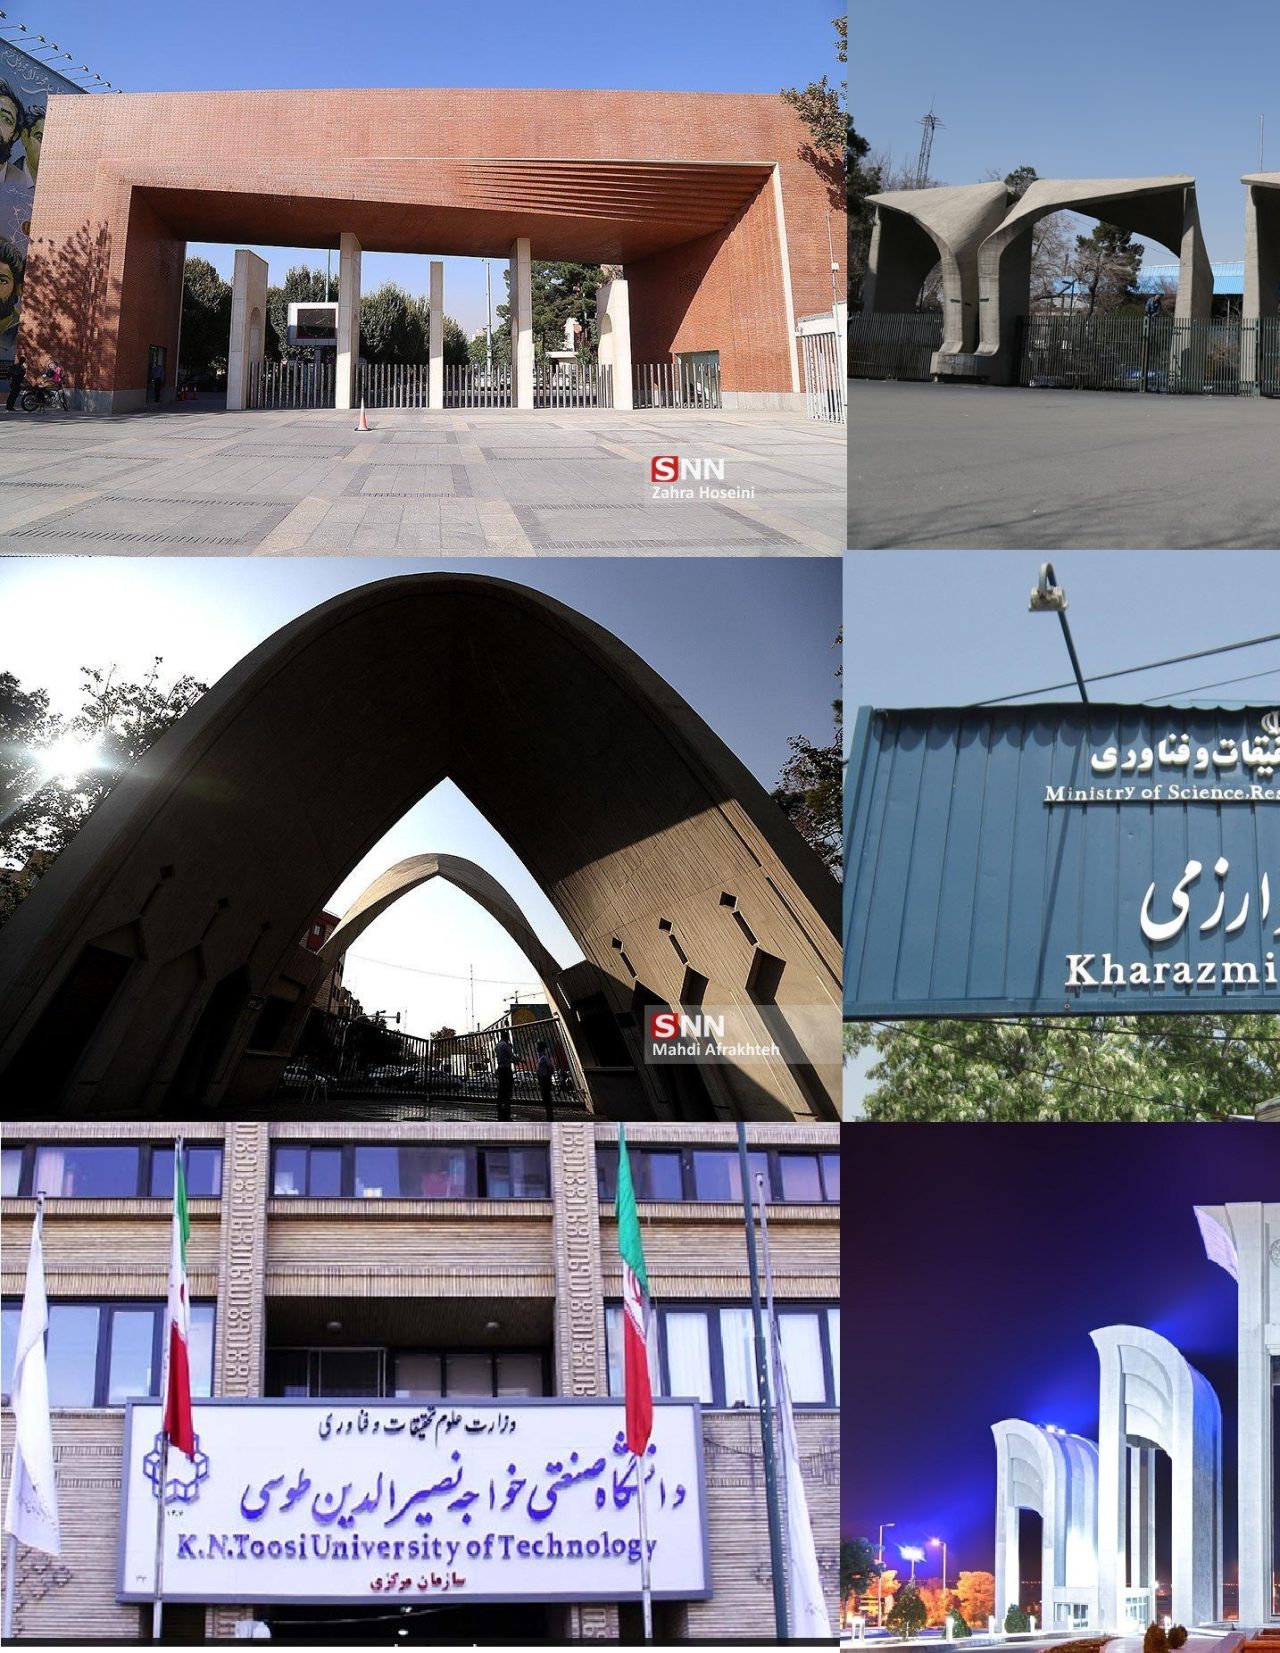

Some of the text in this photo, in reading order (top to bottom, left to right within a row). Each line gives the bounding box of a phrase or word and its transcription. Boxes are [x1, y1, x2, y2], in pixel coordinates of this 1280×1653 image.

[1091, 733, 1191, 772] فناوری
[1195, 748, 1210, 769] و
[1045, 785, 1135, 801] Ministry
[1141, 785, 1163, 800] of
[1065, 952, 1278, 987] Kharazmi
[319, 1405, 516, 1448] وزارت علوم تحقیقات و فناوری
[241, 1468, 311, 1522] طوسی
[448, 1463, 527, 1526] خواجه
[527, 1451, 606, 1521] صنعتی
[178, 1531, 657, 1565] K.N.Toosi University of Technology
[370, 1571, 466, 1592] سازمان مرکزی
